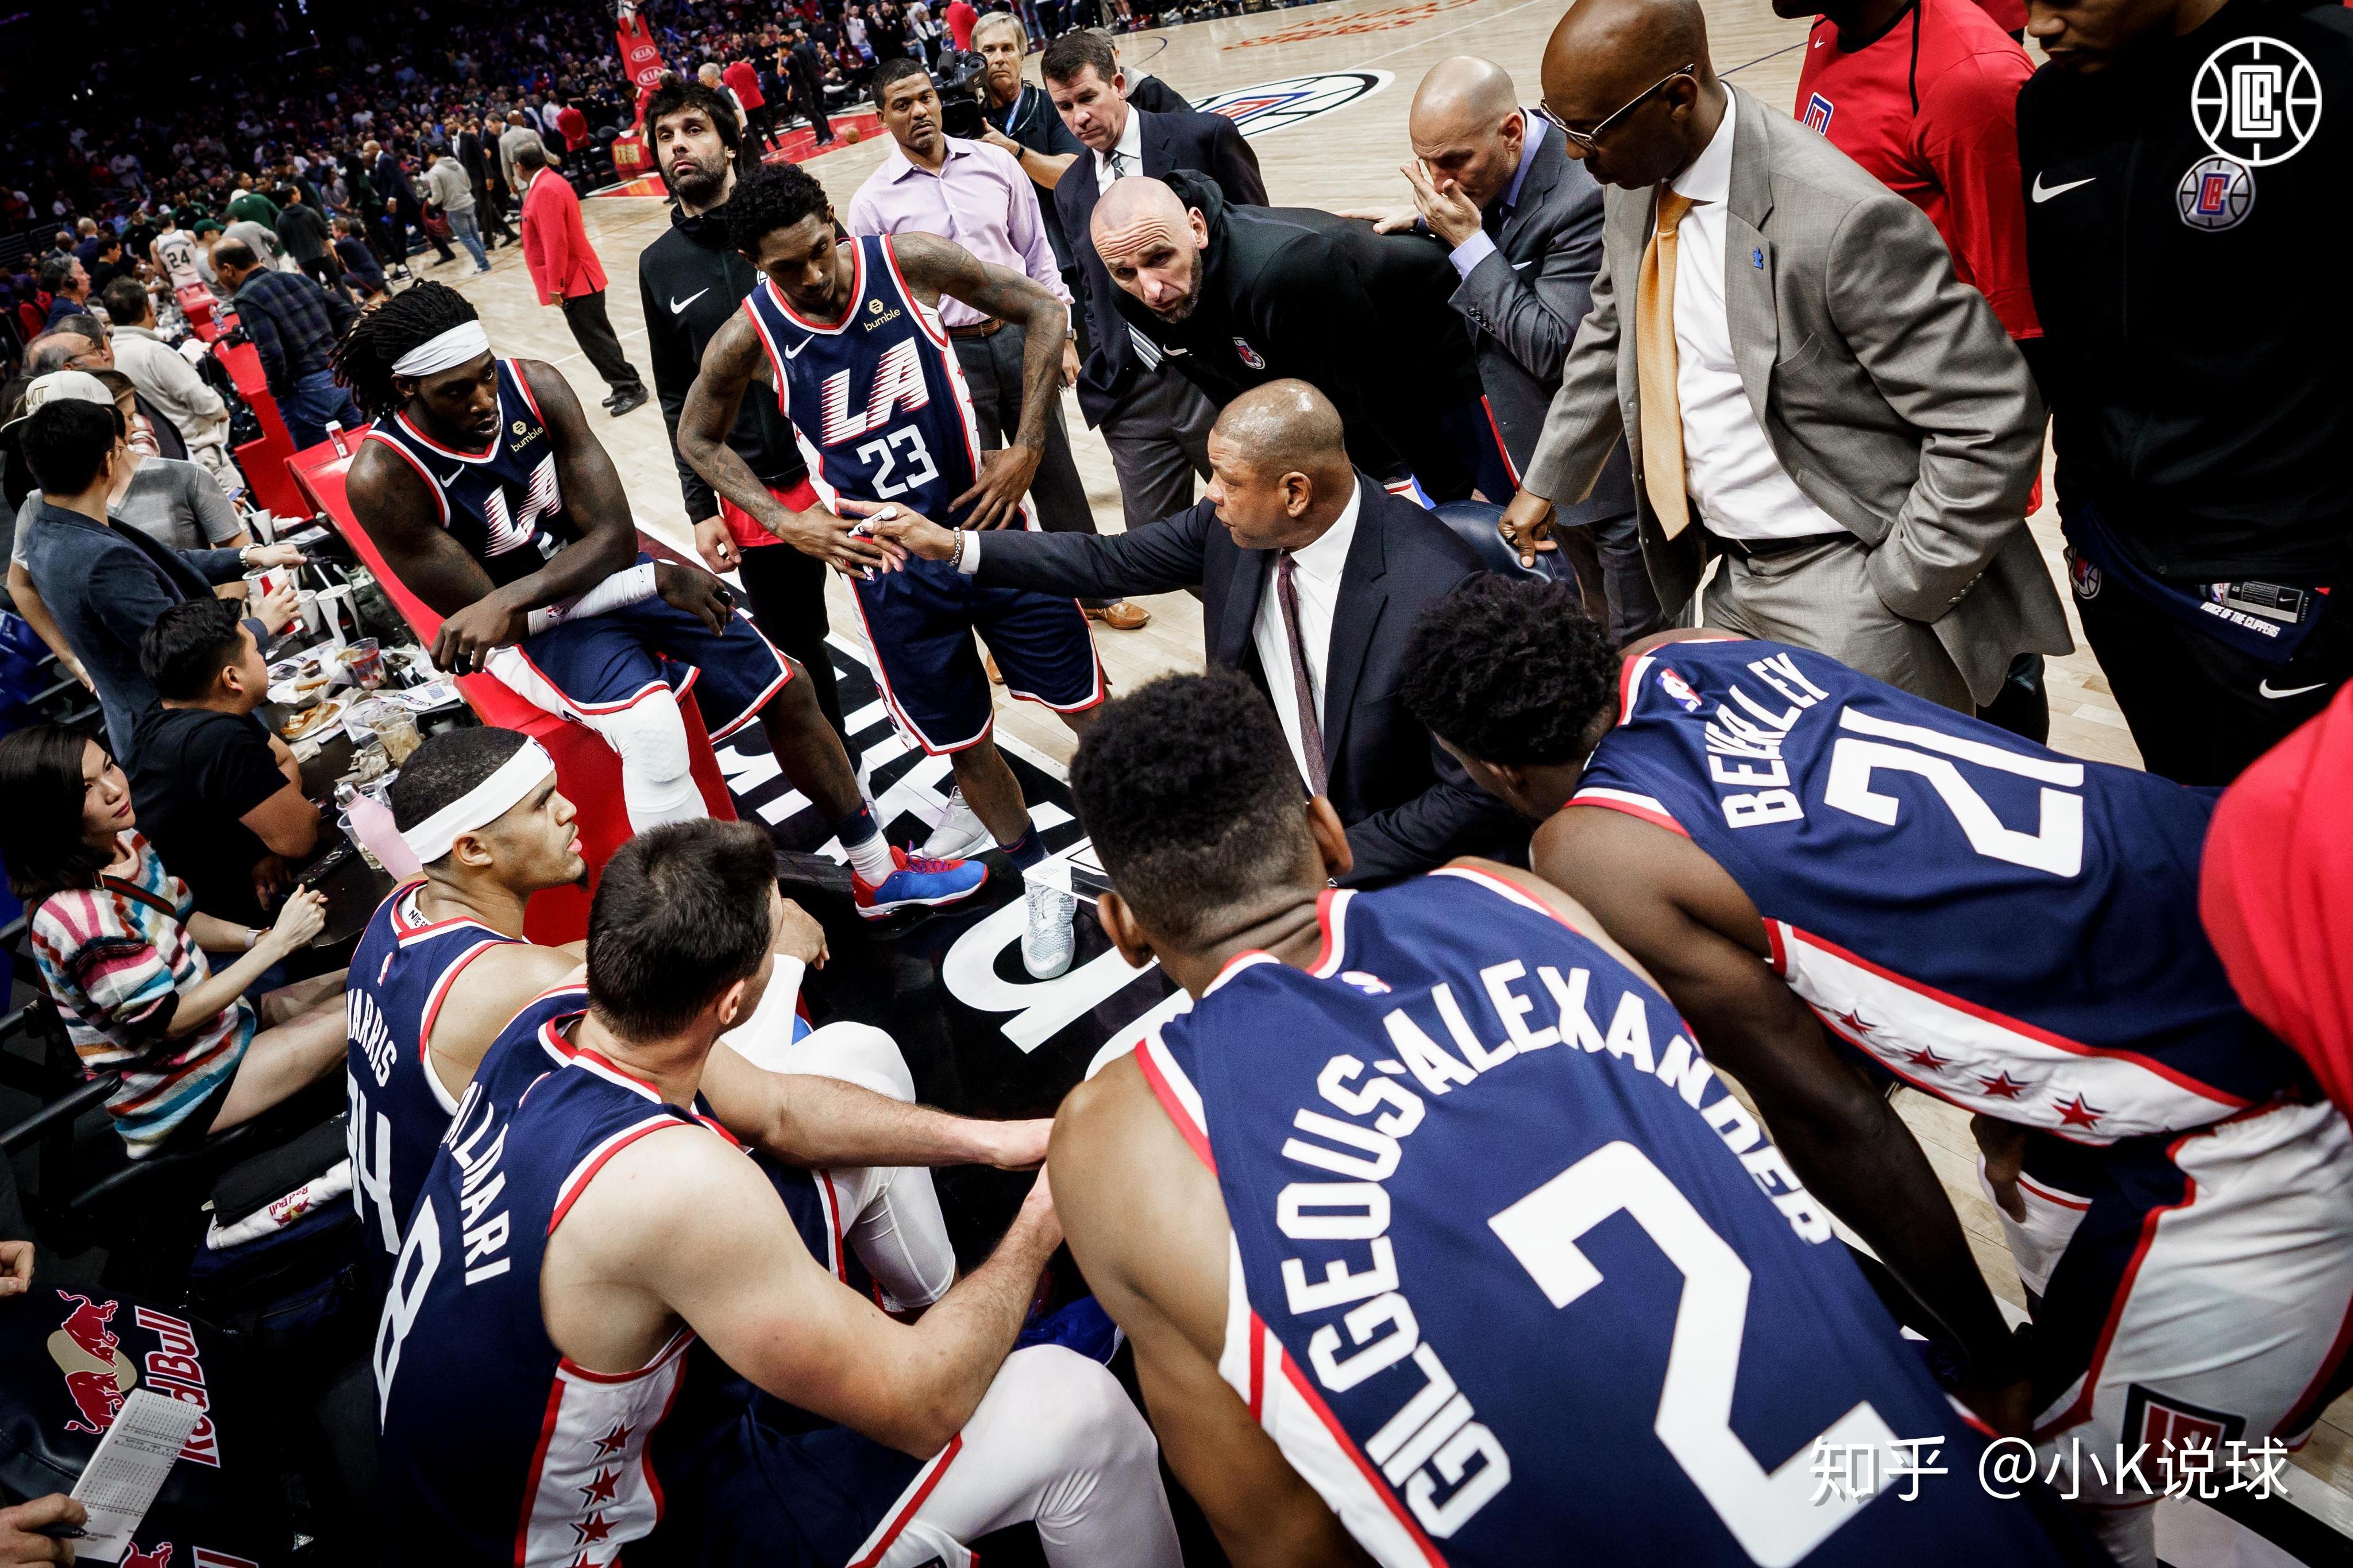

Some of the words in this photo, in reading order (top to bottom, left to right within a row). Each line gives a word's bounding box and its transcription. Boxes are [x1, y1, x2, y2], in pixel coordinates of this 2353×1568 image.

[167, 249, 191, 269] 24
[863, 307, 901, 331] bumble
[821, 336, 929, 447] LA
[511, 426, 543, 453] bumble
[856, 424, 939, 500] 23
[483, 450, 562, 558] LA
[2220, 608, 2234, 619] OF
[2229, 611, 2247, 625] THE
[2243, 616, 2281, 638] CLIPPERS
[1824, 707, 2085, 878] 21
[373, 1195, 441, 1436] 8
[1487, 1140, 1912, 1568] 2
